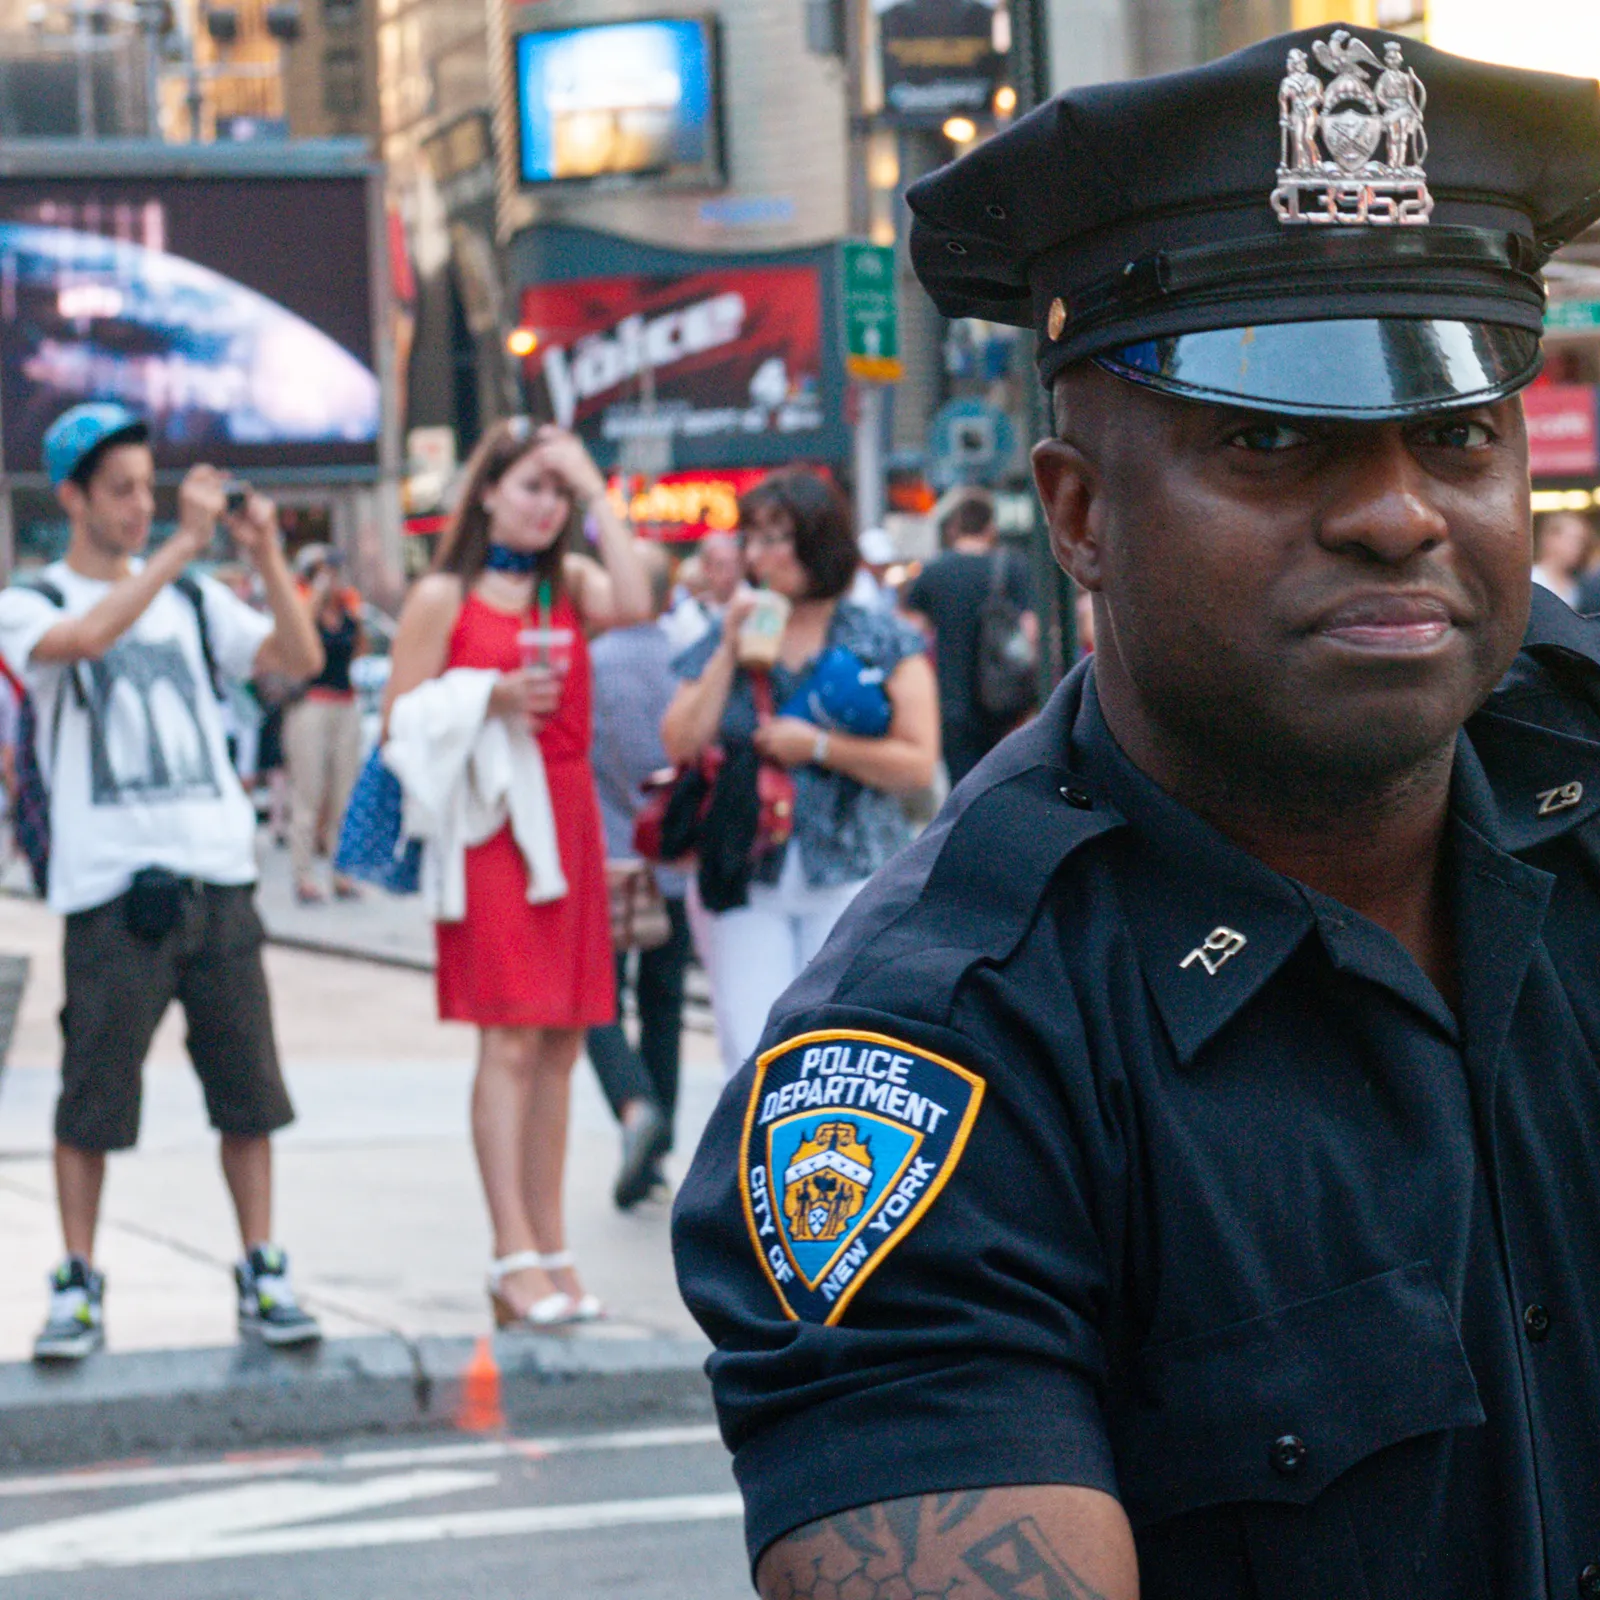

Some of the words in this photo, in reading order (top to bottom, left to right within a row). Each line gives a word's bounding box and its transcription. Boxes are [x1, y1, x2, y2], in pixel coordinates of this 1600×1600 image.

[1535, 780, 1584, 816] 79
[1179, 925, 1248, 976] 79
[799, 1046, 914, 1086] POLICE
[756, 1075, 949, 1135] DEPARTMENT
[749, 1164, 776, 1238] CITY
[767, 1243, 796, 1285] OF
[818, 1237, 870, 1302] NEW
[868, 1155, 937, 1235] YORK
